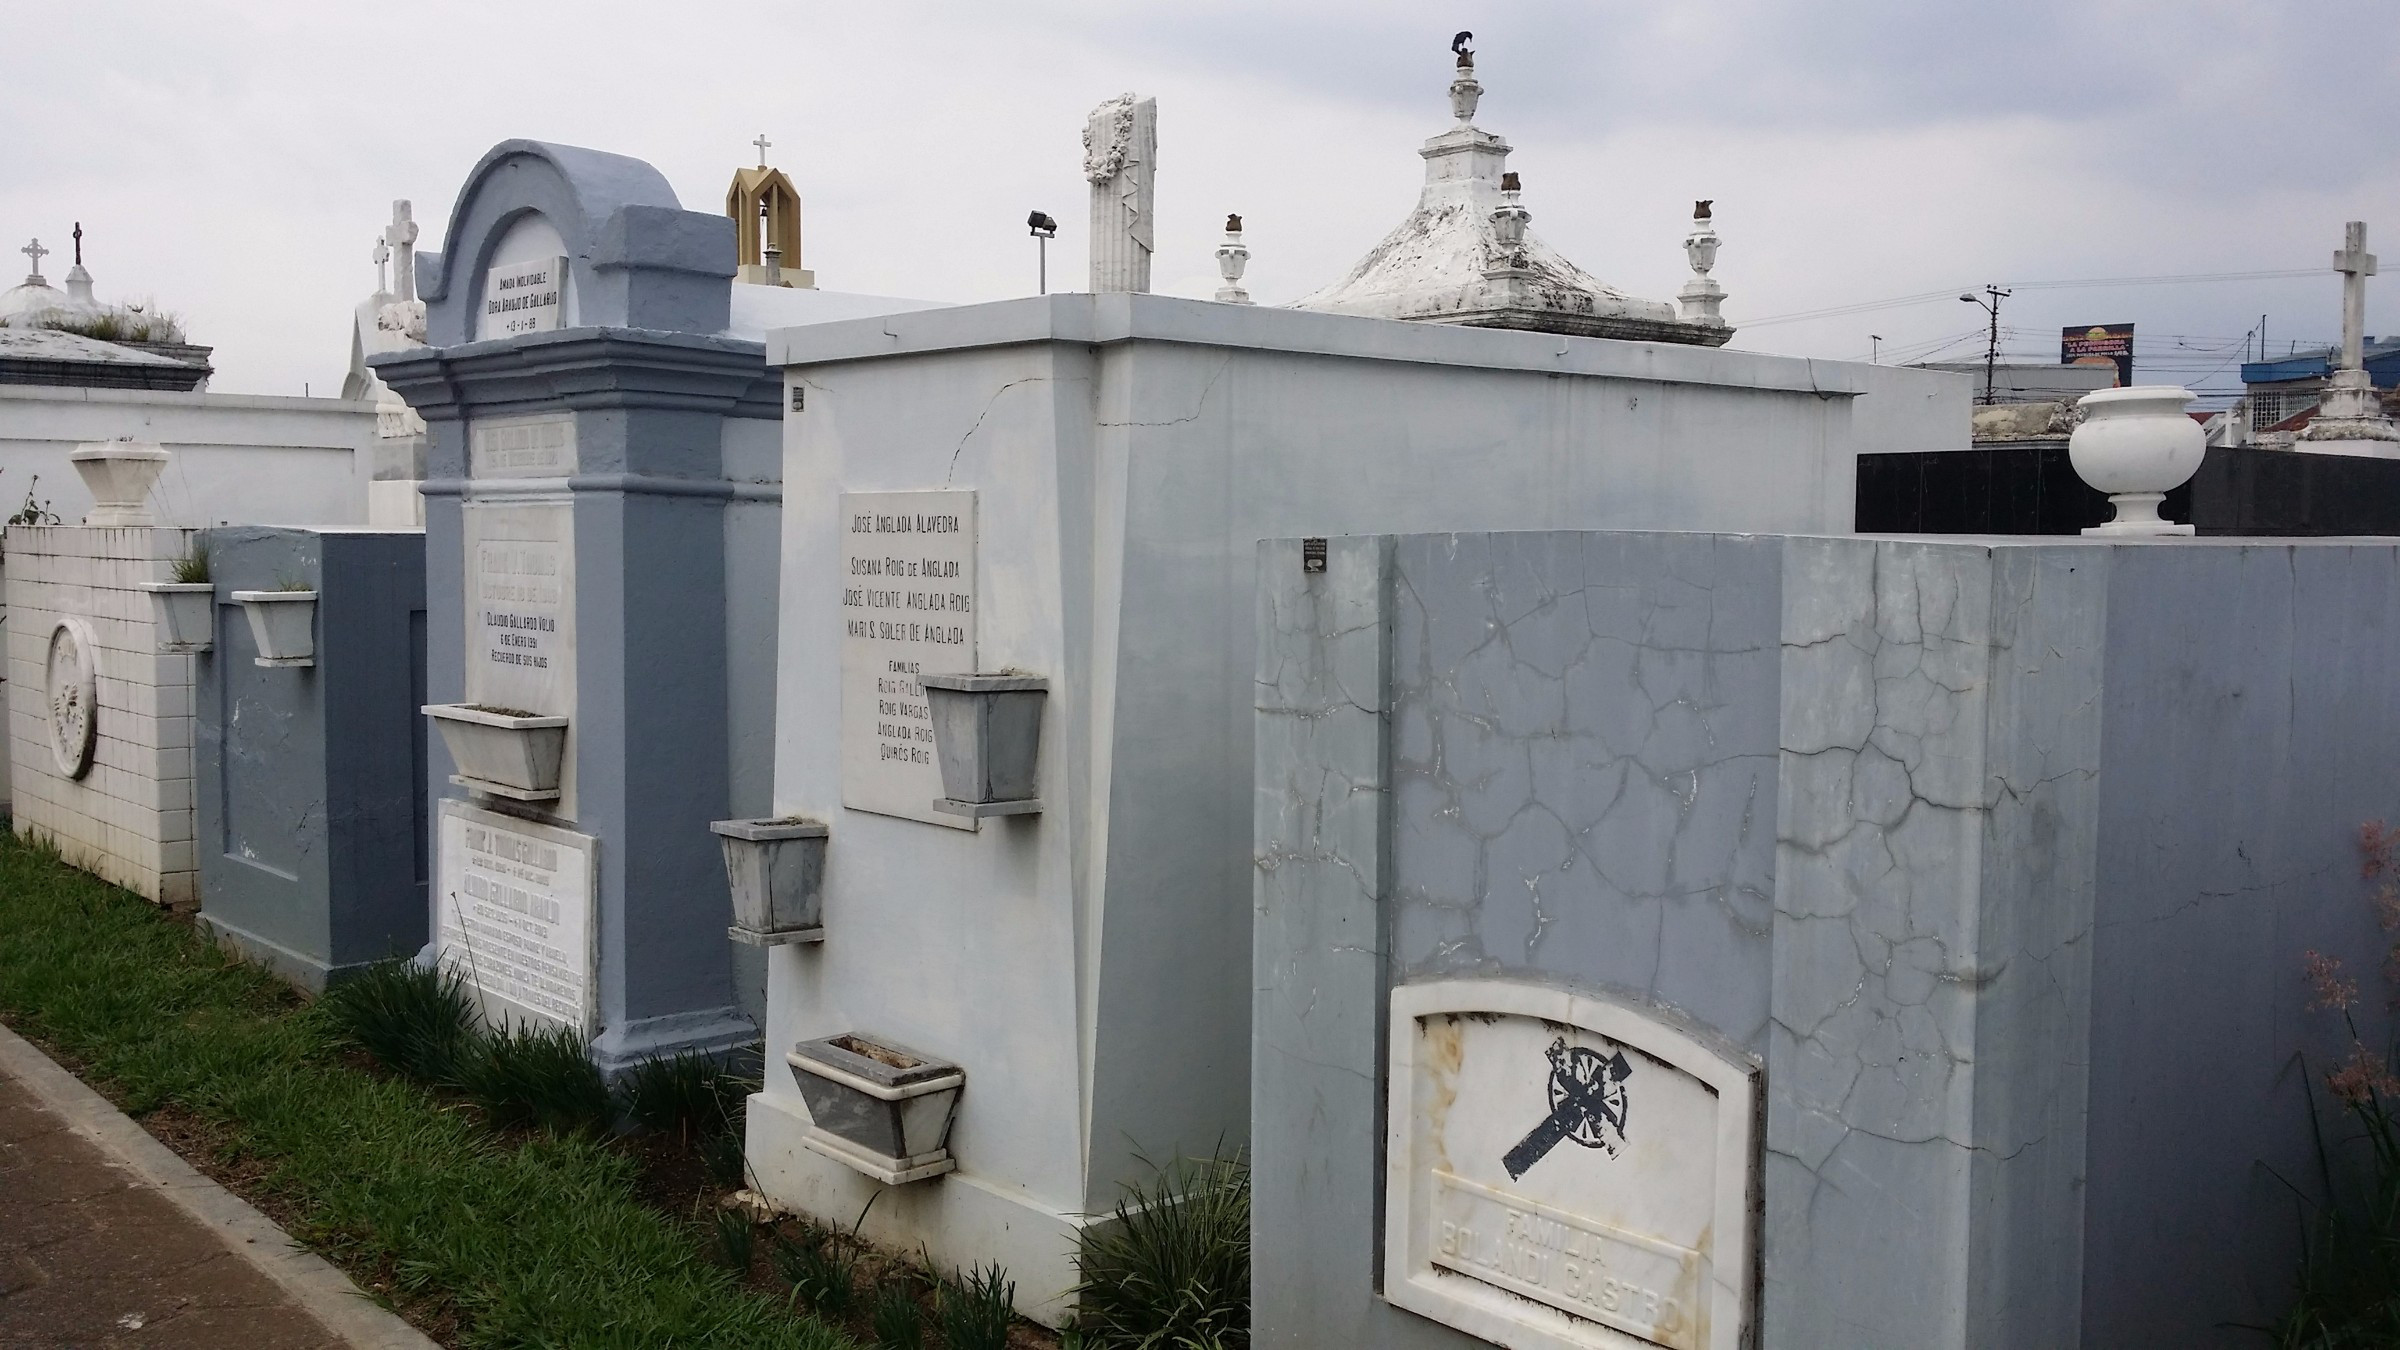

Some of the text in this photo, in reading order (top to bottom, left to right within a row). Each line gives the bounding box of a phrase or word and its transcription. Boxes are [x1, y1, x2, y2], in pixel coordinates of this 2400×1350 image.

[499, 272, 547, 290] AMADA INOLVIDABLE
[488, 300, 501, 314] DORA
[530, 291, 557, 308] GALLARDO
[875, 514, 912, 533] ANGLADA
[916, 513, 959, 533] ALAVEDRA
[851, 556, 959, 578] SUSANA ROIG DE ANGLADA
[843, 584, 970, 613] JOSÉ VICENTE ANGLADA ROIG
[486, 611, 508, 628] CLAUDIO
[510, 613, 537, 631] GALLARDO
[848, 619, 866, 638] MARI
[880, 621, 906, 641] SOLER
[909, 623, 921, 642] DE
[924, 623, 965, 645] ANGLADA
[491, 649, 515, 664] RECUERDO
[515, 653, 522, 665] DE
[533, 656, 548, 669] HIJOS
[888, 660, 920, 674] FAMILIAS
[880, 699, 929, 720] ROIG VARGAS
[877, 721, 933, 743] ANGLADA ROIG
[880, 743, 930, 765] QUIRÓS ROIG
[1506, 1208, 1606, 1267] FAMILIA
[1562, 1262, 1681, 1334] CASTRO
